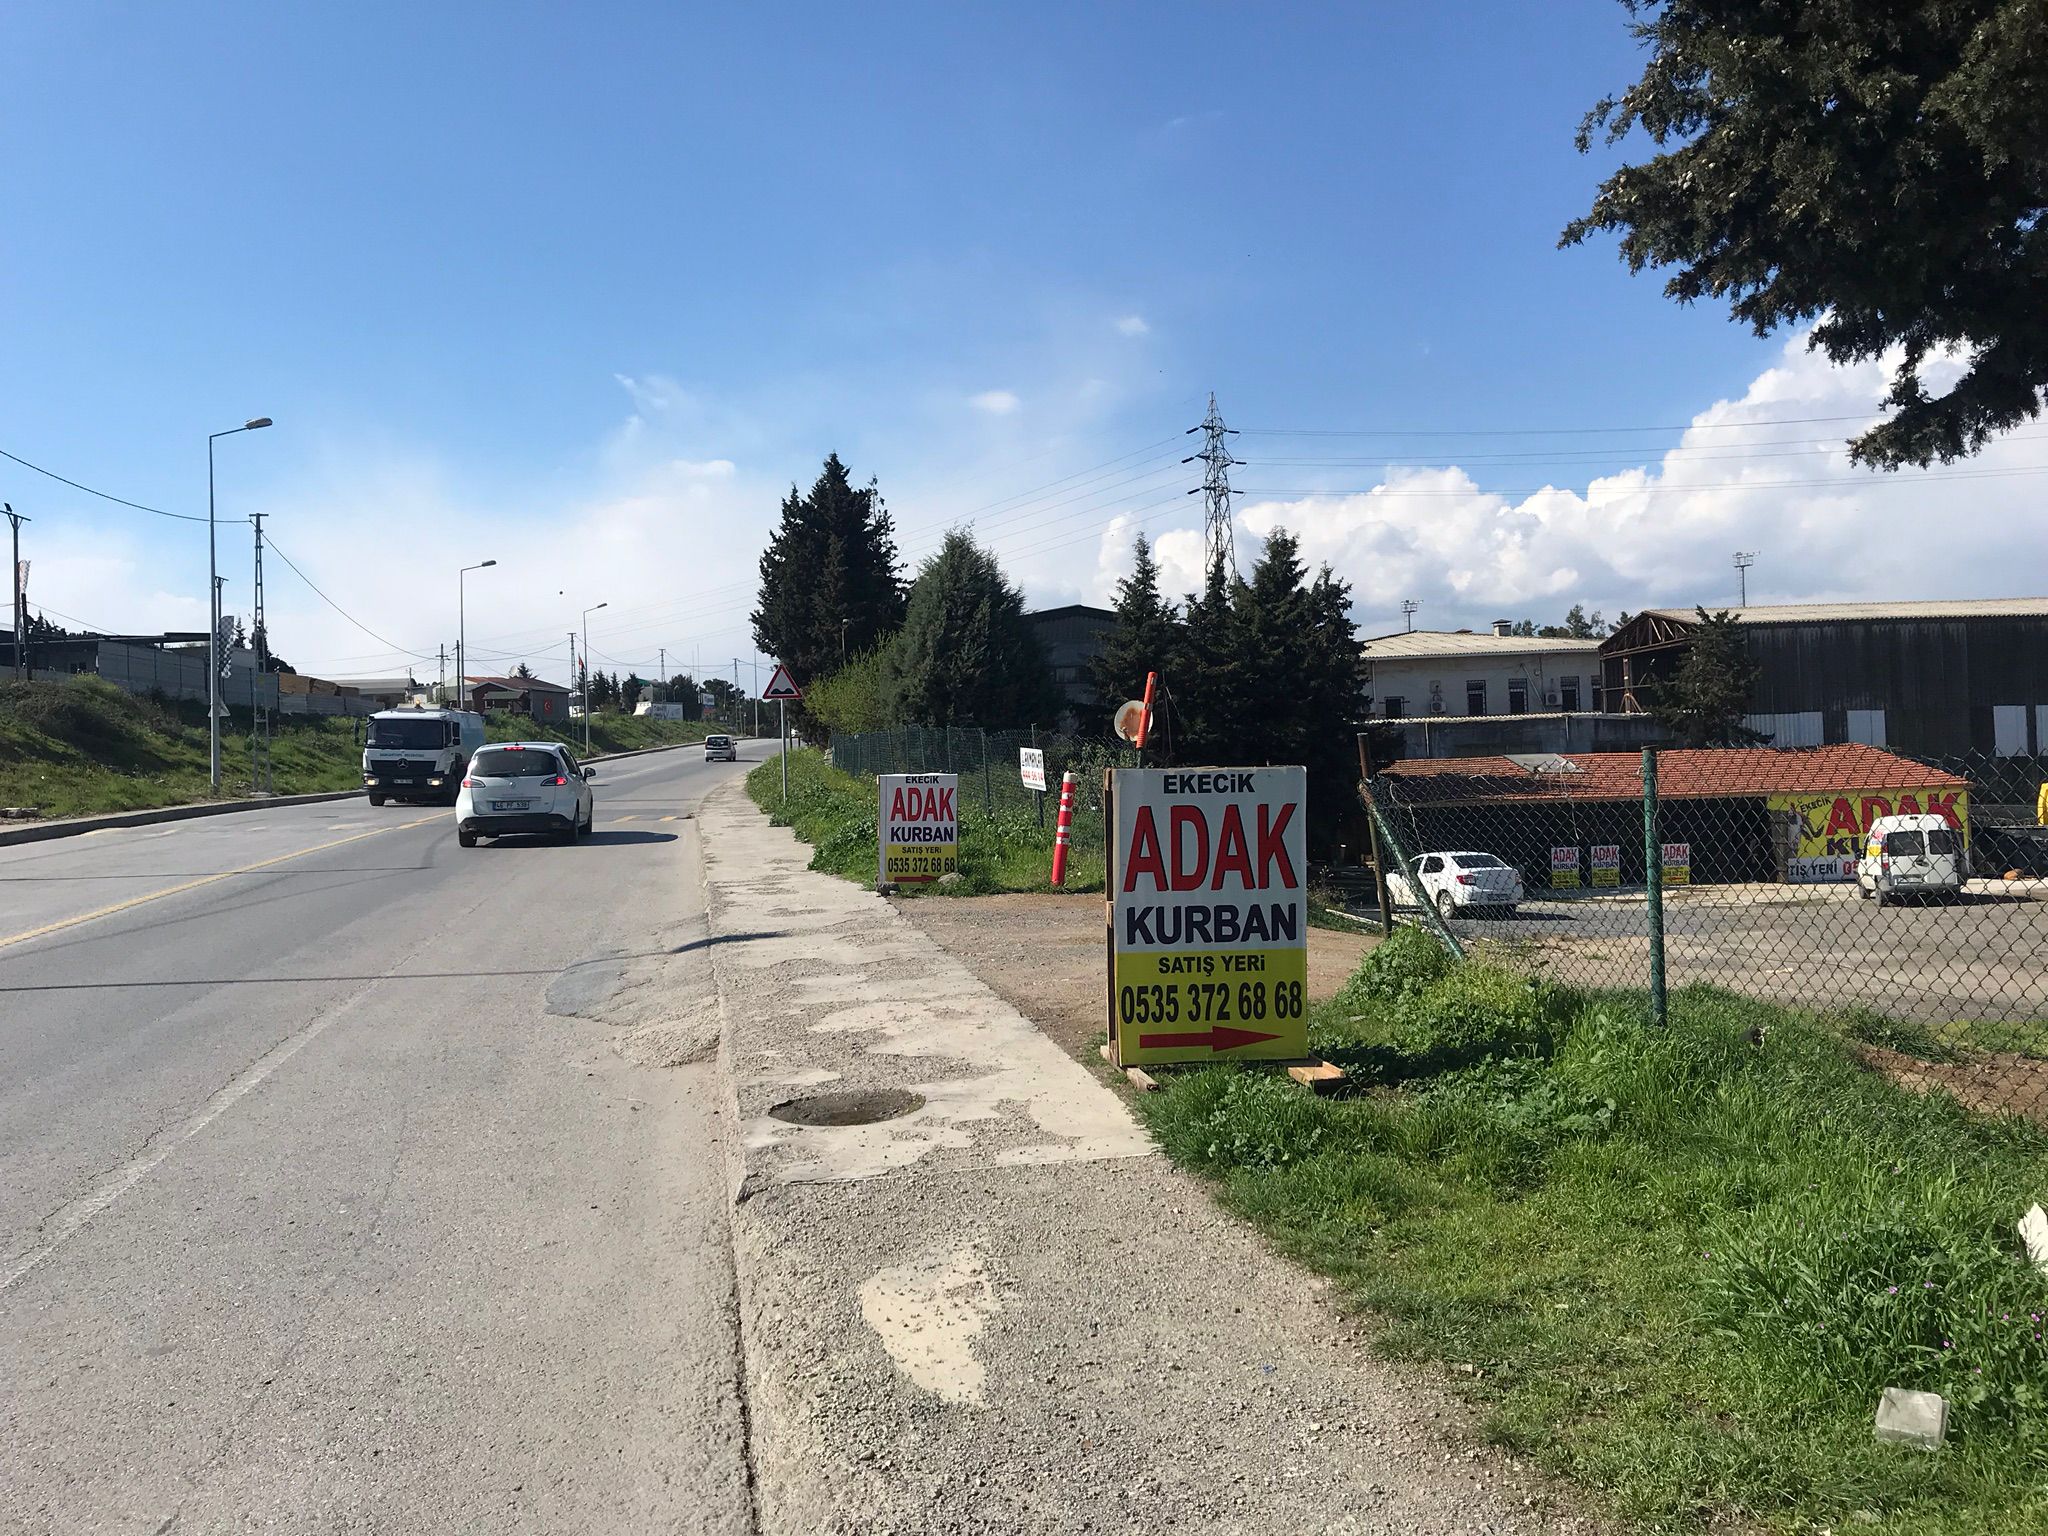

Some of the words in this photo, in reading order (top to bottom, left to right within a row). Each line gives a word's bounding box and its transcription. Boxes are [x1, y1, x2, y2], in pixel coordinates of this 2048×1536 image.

[890, 787, 955, 822] ADAK
[1825, 792, 1965, 836] ADAK
[890, 826, 954, 842] KURBAN
[902, 847, 923, 855] SATIŞ
[1123, 802, 1299, 893] ADAK
[1553, 848, 1577, 862] ADAK
[1593, 846, 1618, 861] ADAK
[1664, 845, 1688, 859] ADAK
[888, 857, 909, 873] 0535
[912, 857, 928, 873] 372
[931, 857, 942, 873] 68
[944, 857, 955, 873] 68
[1126, 902, 1297, 945] KURBAN
[1158, 955, 1215, 977] SATIŞ
[1120, 984, 1179, 1025] 0535
[1187, 982, 1231, 1022] 372
[1238, 981, 1267, 1020] 68
[1274, 979, 1303, 1019] 68
